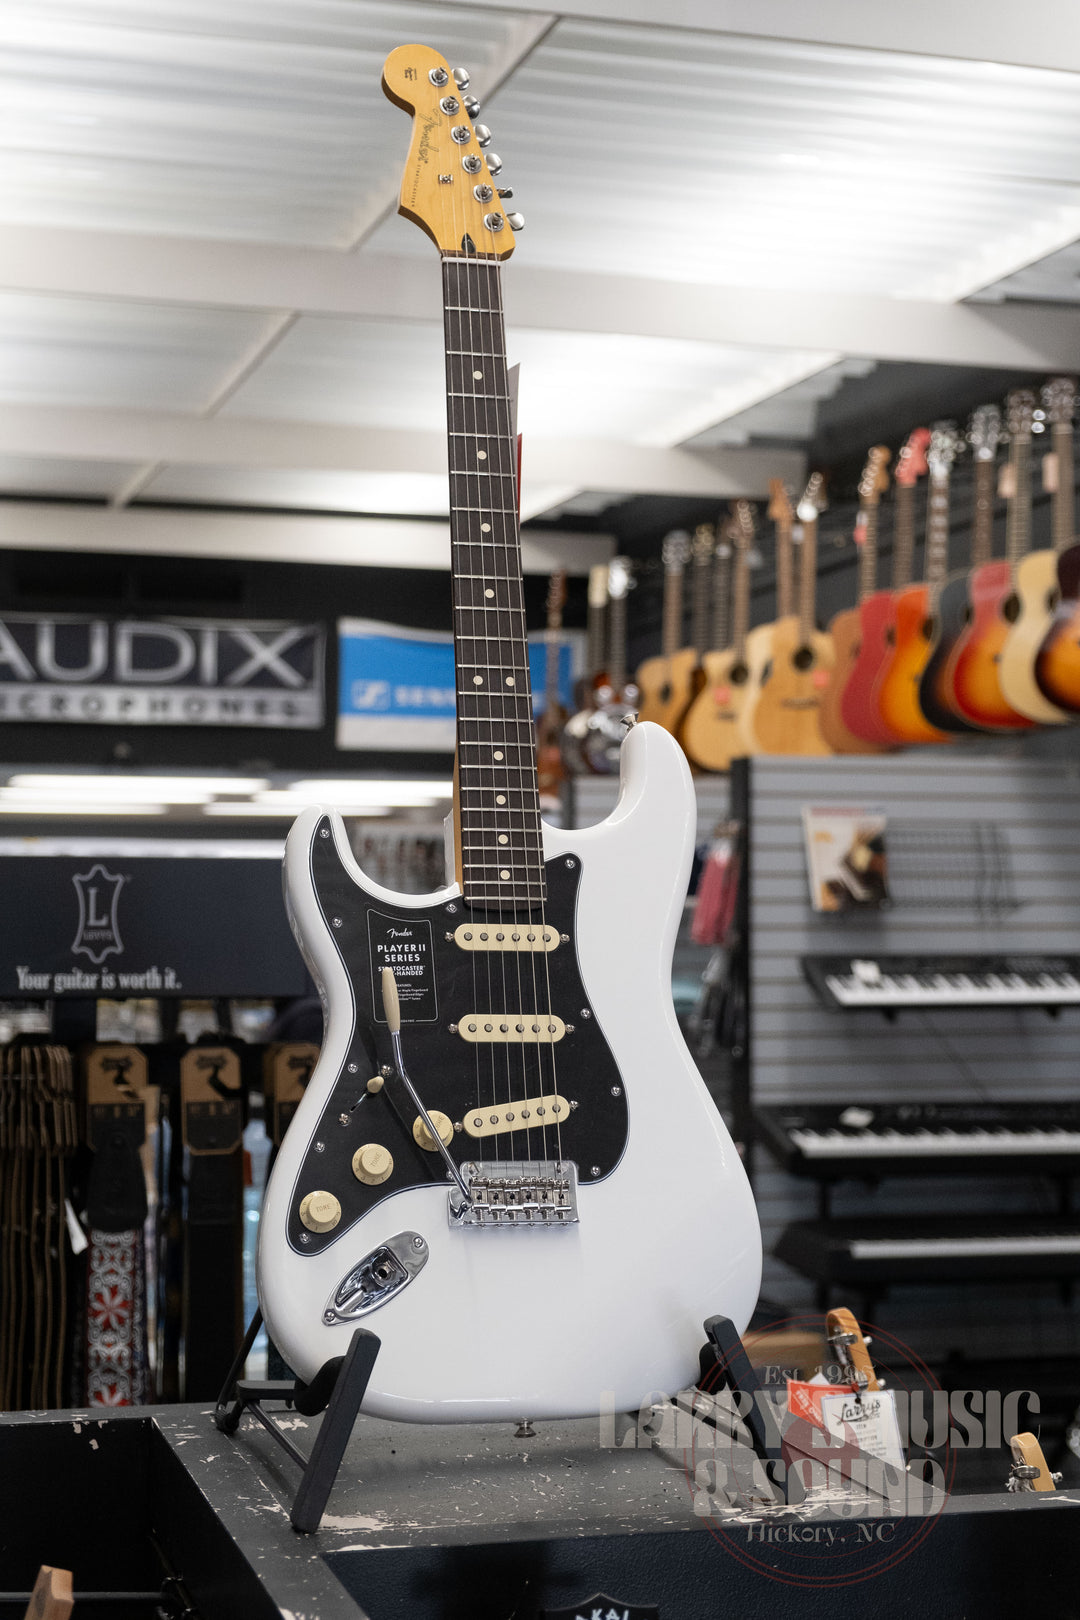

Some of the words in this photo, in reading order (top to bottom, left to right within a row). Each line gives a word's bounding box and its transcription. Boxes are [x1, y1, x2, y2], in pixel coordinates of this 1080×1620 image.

[386, 928, 413, 938] Fender
[377, 944, 417, 952] PLAYER
[384, 954, 421, 962] SERIES
[16, 966, 50, 990] Your
[54, 967, 99, 993] guitar
[101, 967, 116, 990] is
[118, 966, 162, 990] worth
[164, 967, 182, 990] it.
